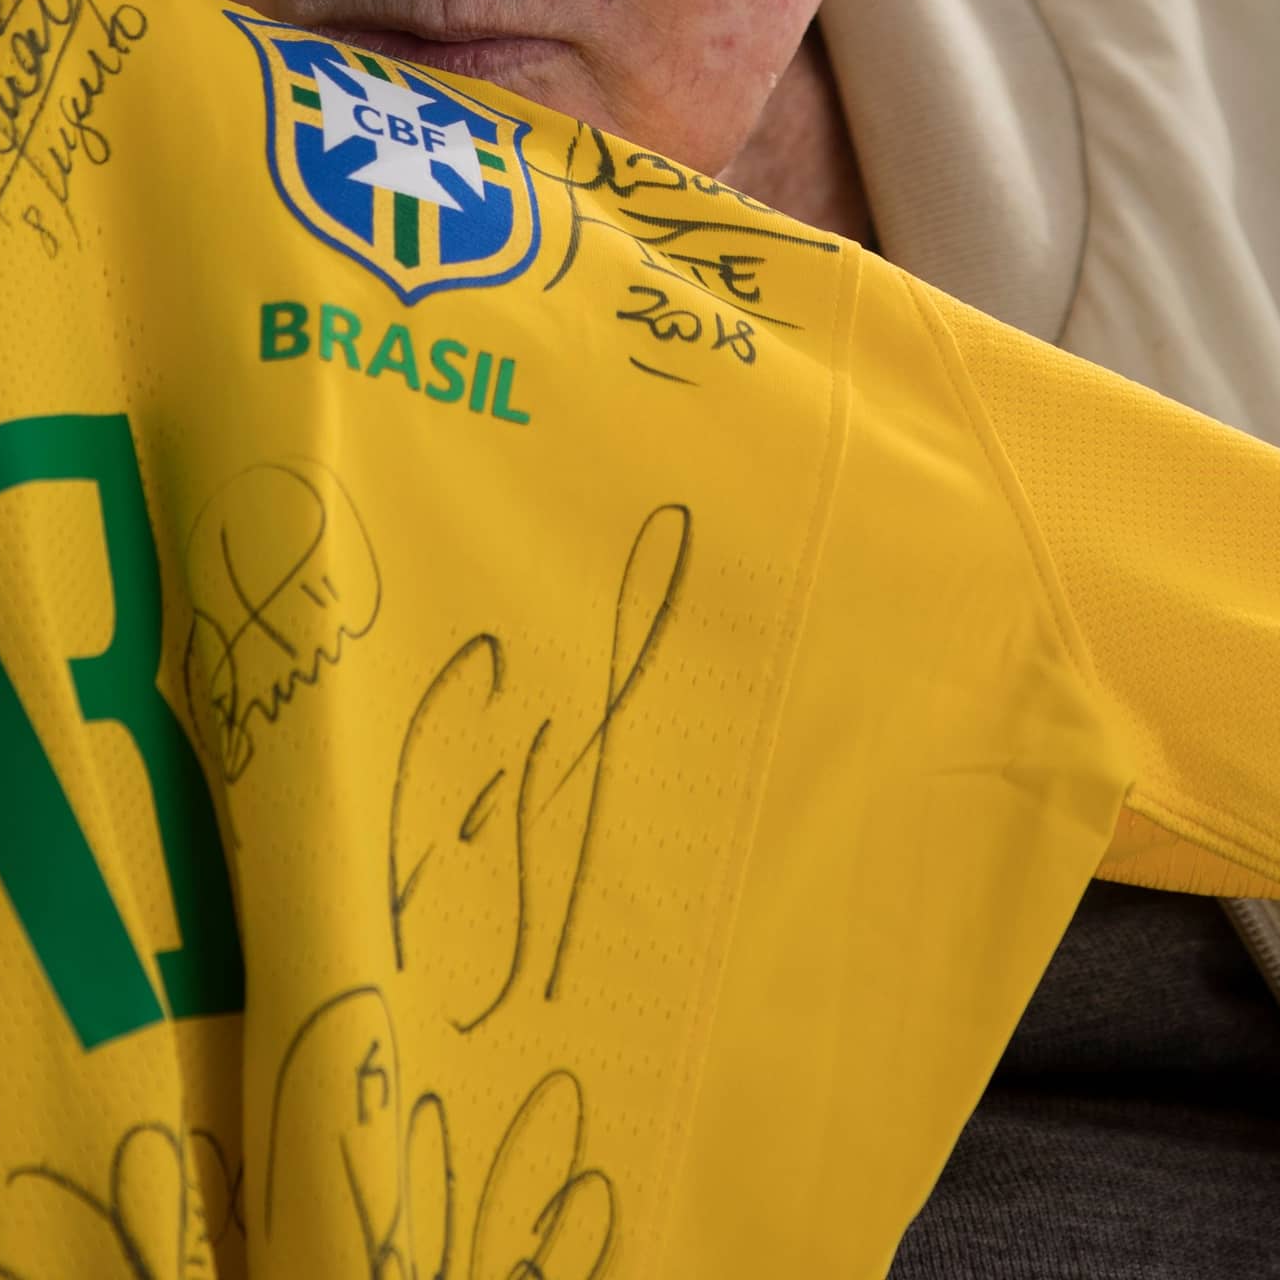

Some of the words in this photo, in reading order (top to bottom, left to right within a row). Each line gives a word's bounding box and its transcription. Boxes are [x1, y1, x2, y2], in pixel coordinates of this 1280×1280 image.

[352, 103, 447, 154] CBF
[260, 300, 531, 426] BRASIL
[616, 285, 758, 366] 2018
